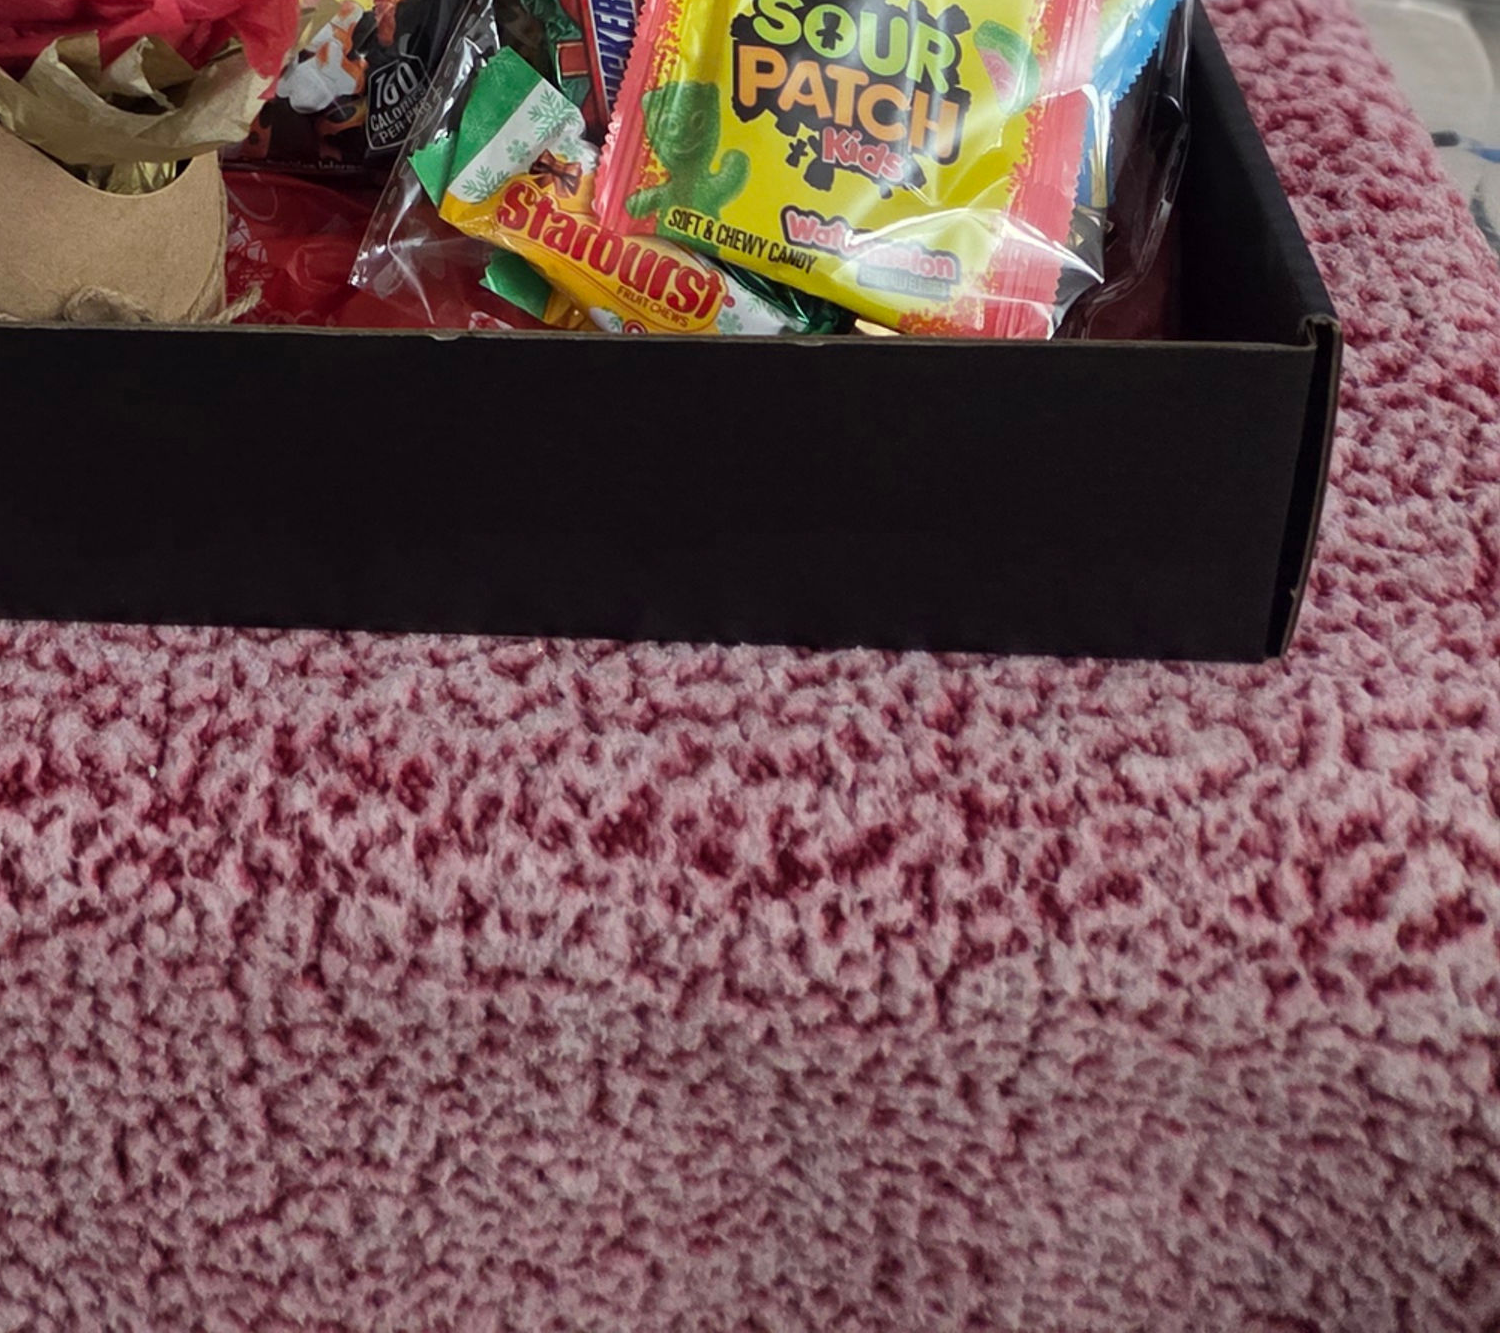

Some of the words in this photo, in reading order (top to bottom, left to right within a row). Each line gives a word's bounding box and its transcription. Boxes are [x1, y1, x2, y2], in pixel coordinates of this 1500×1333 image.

[374, 62, 419, 109] 160
[738, 44, 960, 159] PATCH
[378, 121, 405, 144] PER
[822, 126, 905, 182] Kids
[668, 208, 703, 235] SOFT
[703, 219, 715, 241] &
[715, 223, 768, 259] CHEWY
[768, 241, 818, 275] CANDY
[617, 284, 650, 308] FRUIT
[650, 302, 690, 328] CHEWS
